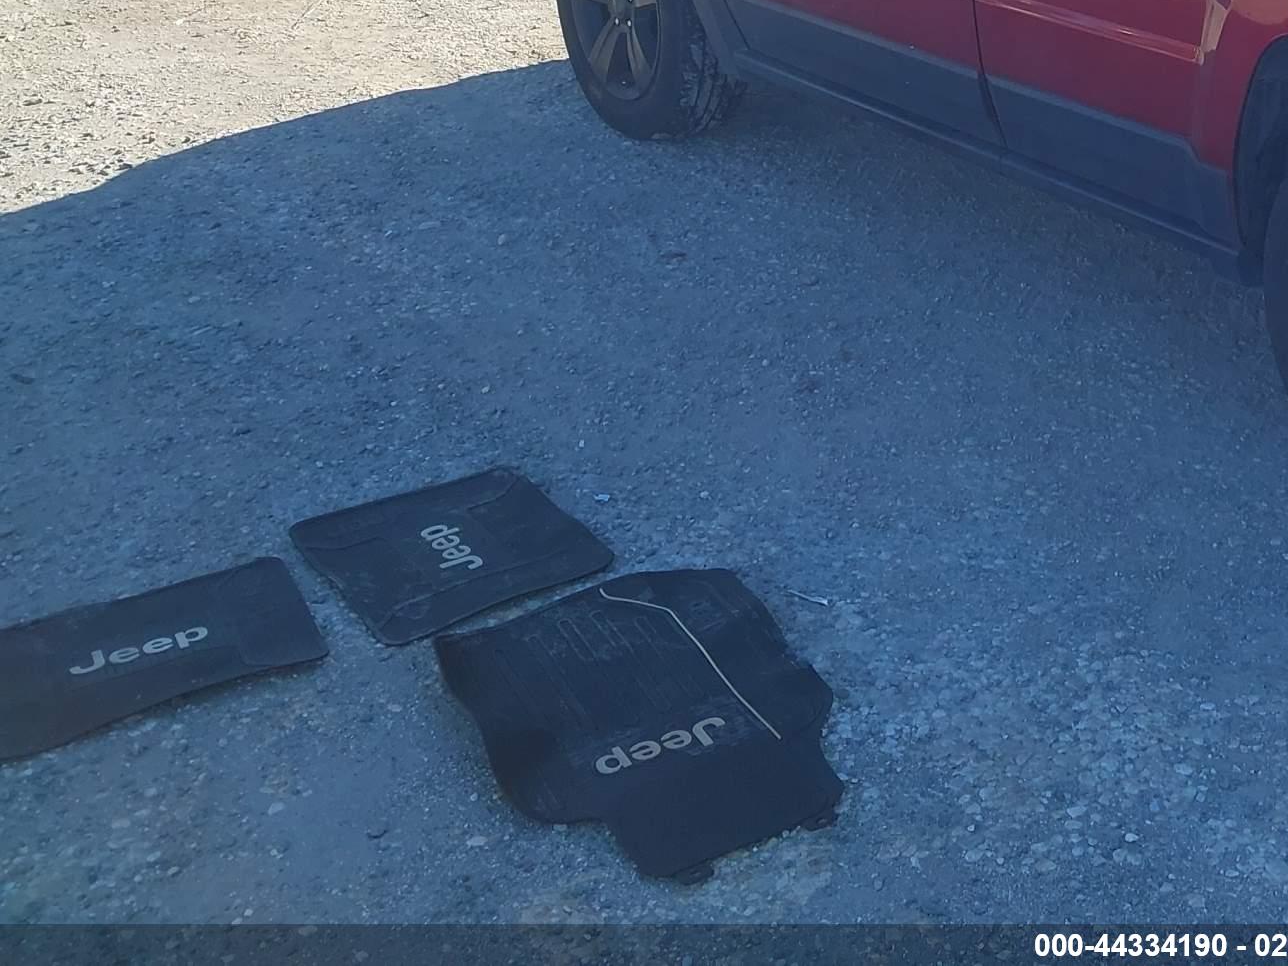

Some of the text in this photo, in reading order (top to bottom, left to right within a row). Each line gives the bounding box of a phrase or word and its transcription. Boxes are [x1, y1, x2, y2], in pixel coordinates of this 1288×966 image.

[420, 524, 483, 569] Jeep
[68, 626, 209, 675] Jeep
[594, 716, 727, 775] Jeep
